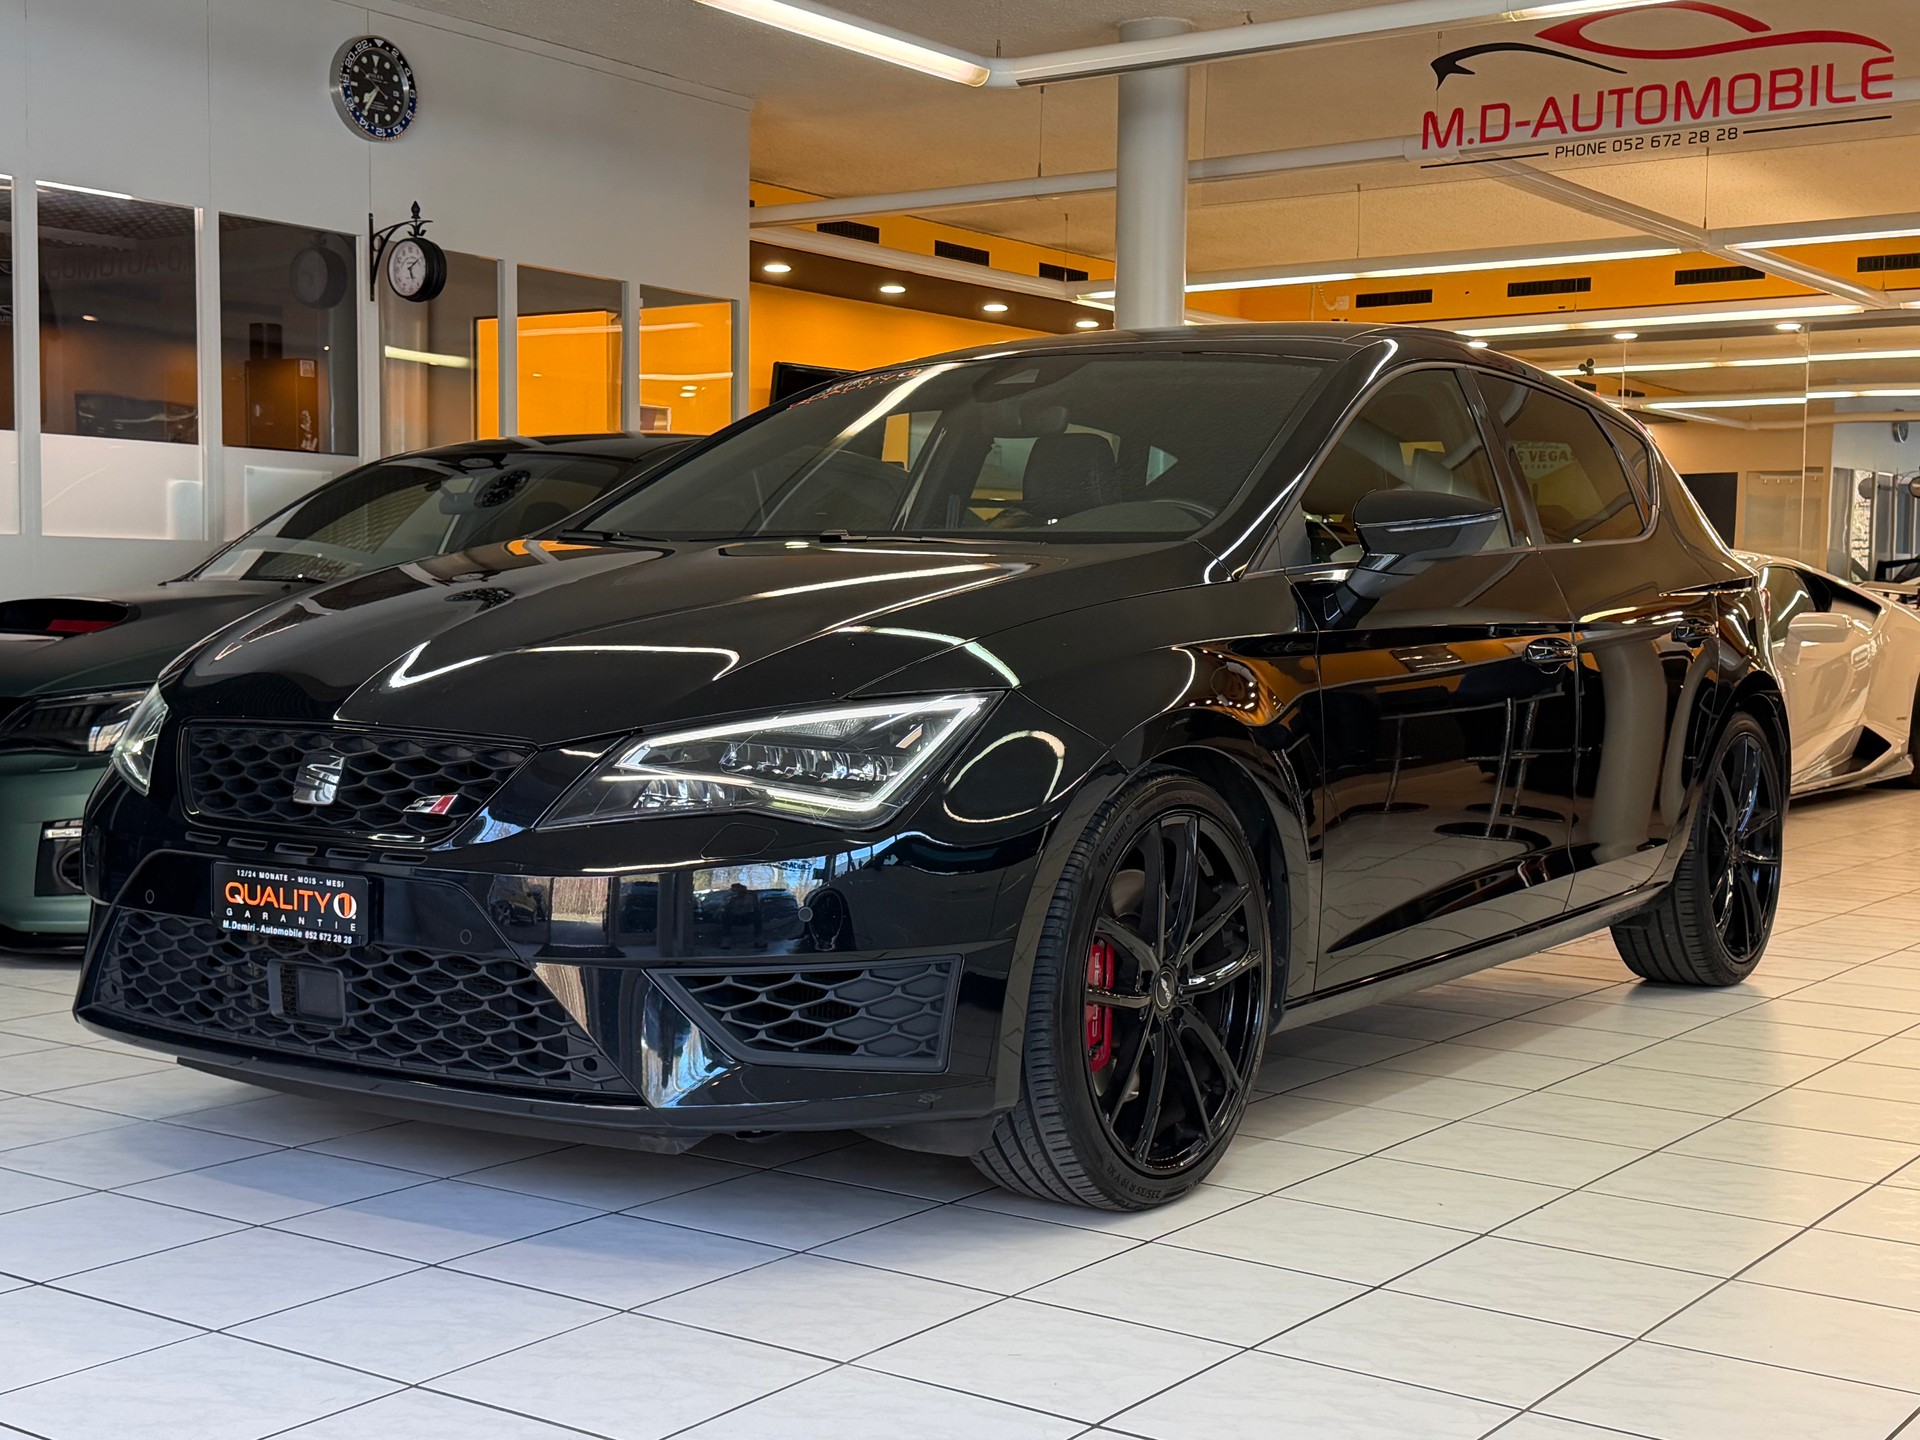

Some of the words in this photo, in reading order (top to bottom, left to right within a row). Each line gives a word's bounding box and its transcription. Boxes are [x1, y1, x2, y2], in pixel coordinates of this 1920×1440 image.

[355, 40, 369, 52] 22
[391, 48, 400, 58] 2
[344, 52, 356, 68] 20
[1421, 56, 1895, 150] M.D-AUTOMOBILE
[1555, 141, 1607, 159] PHONE
[1612, 137, 1645, 153] 052
[1650, 133, 1681, 149] 672
[1688, 130, 1710, 144] 28
[1717, 127, 1738, 141] 28
[236, 869, 256, 878] 12/24
[259, 871, 288, 882] MONATE
[298, 876, 317, 885] MOIS
[326, 879, 345, 888] MESI
[225, 881, 331, 914] QUALITY
[226, 908, 356, 932] GARANTIE
[304, 931, 318, 940] 052
[319, 932, 332, 941] 672
[333, 934, 342, 943] 28
[343, 936, 353, 945] 28
